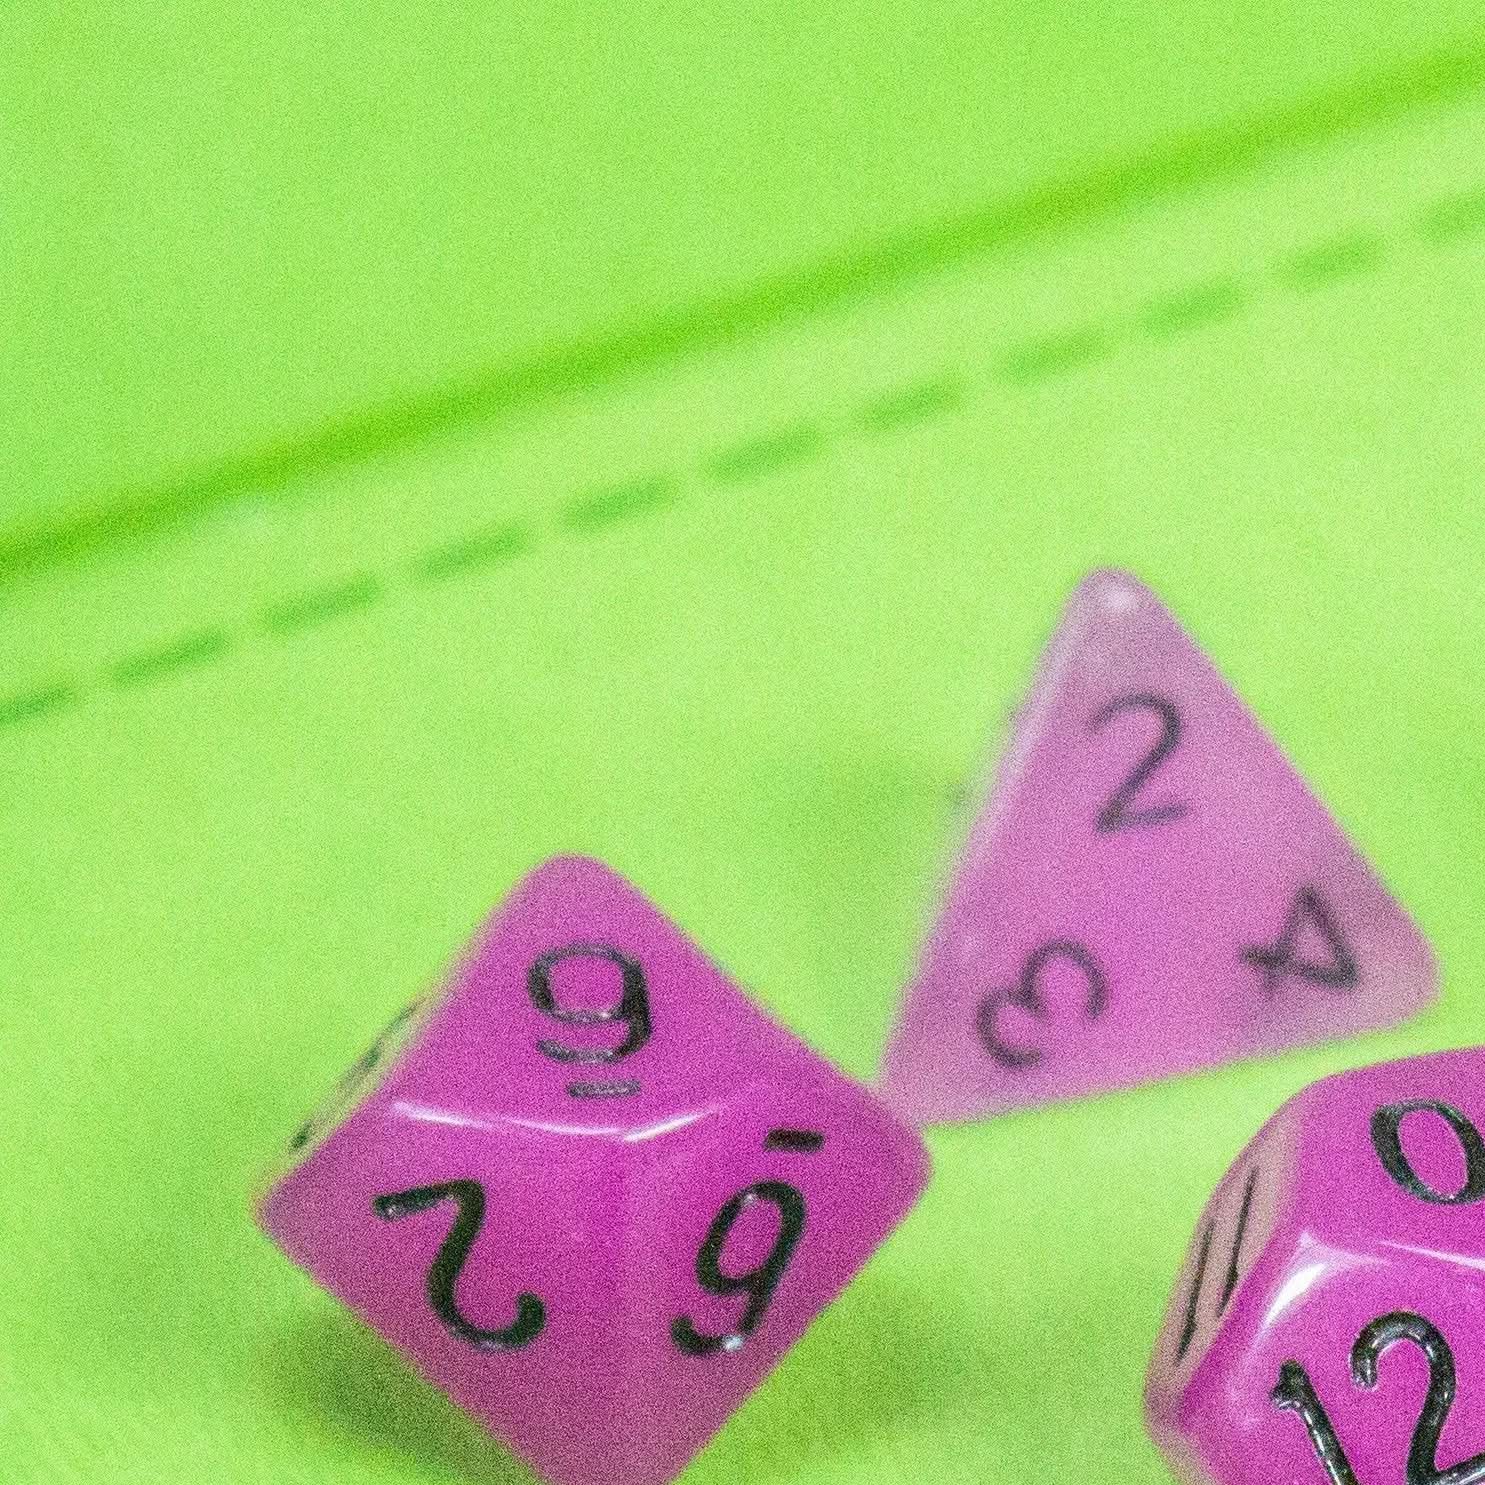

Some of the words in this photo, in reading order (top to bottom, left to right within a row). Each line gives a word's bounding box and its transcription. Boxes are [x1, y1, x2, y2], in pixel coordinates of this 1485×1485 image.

[1085, 690, 1190, 836] 2
[975, 935, 1110, 1071] 3
[1238, 885, 1360, 992] 4
[371, 1177, 547, 1352] 2
